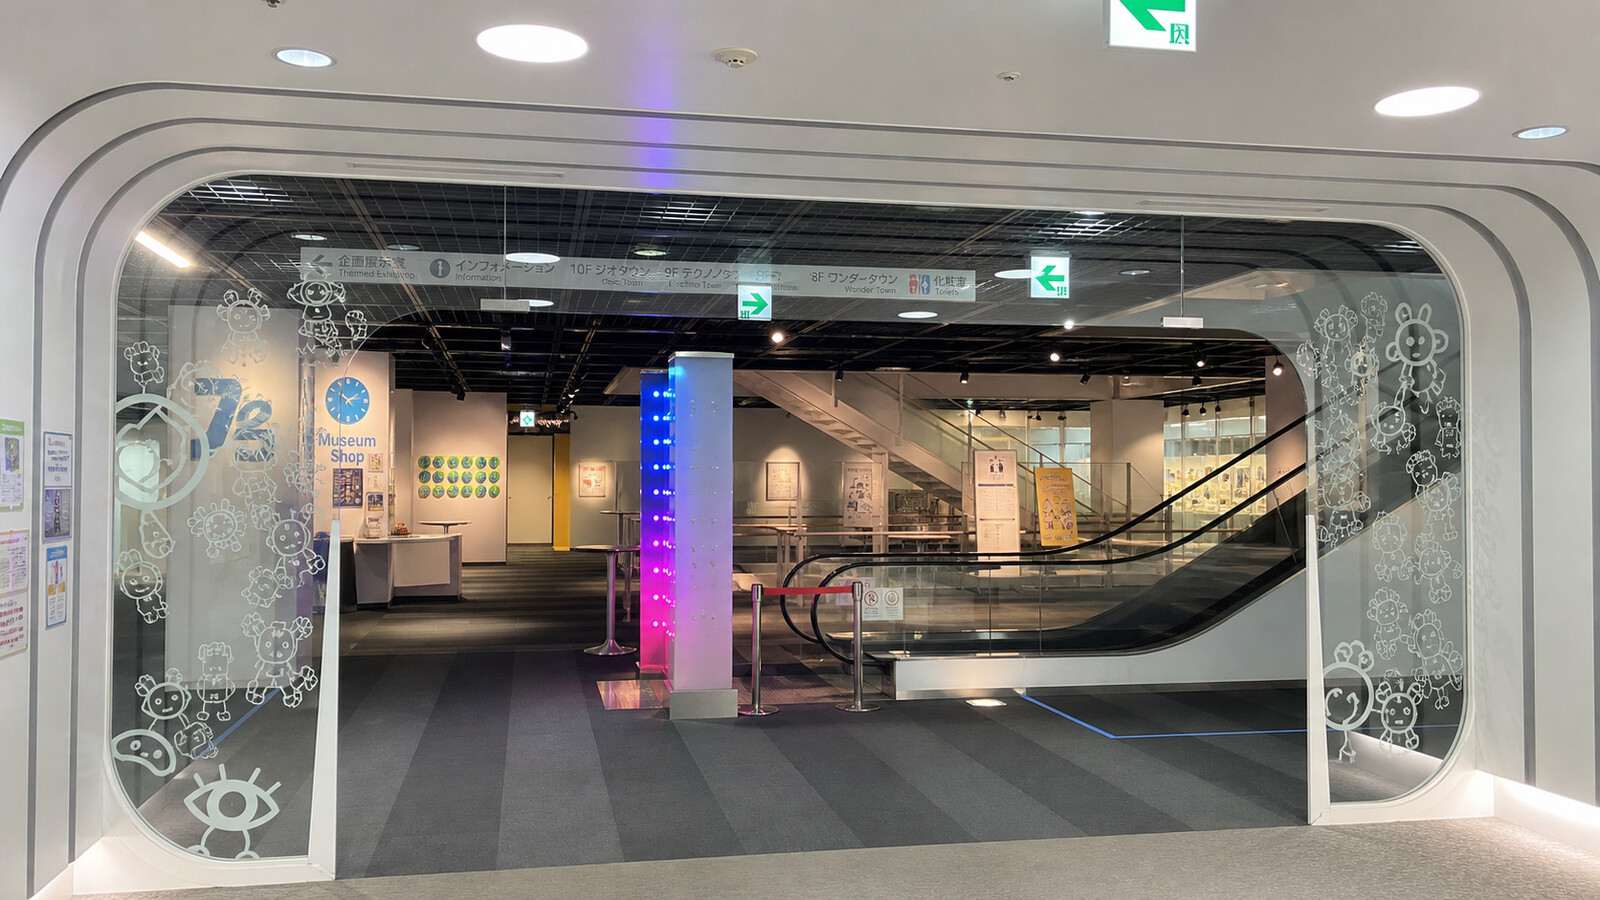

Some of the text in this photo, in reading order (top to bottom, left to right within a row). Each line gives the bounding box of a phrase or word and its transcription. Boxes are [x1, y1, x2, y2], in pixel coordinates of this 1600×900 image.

[570, 263, 650, 277] 10F ジオタウン
[664, 267, 680, 278] 9F
[811, 272, 898, 285] 8F ワンダータウン
[845, 285, 874, 294] Wonder
[318, 433, 376, 447] Museum
[331, 449, 364, 466] Shop
